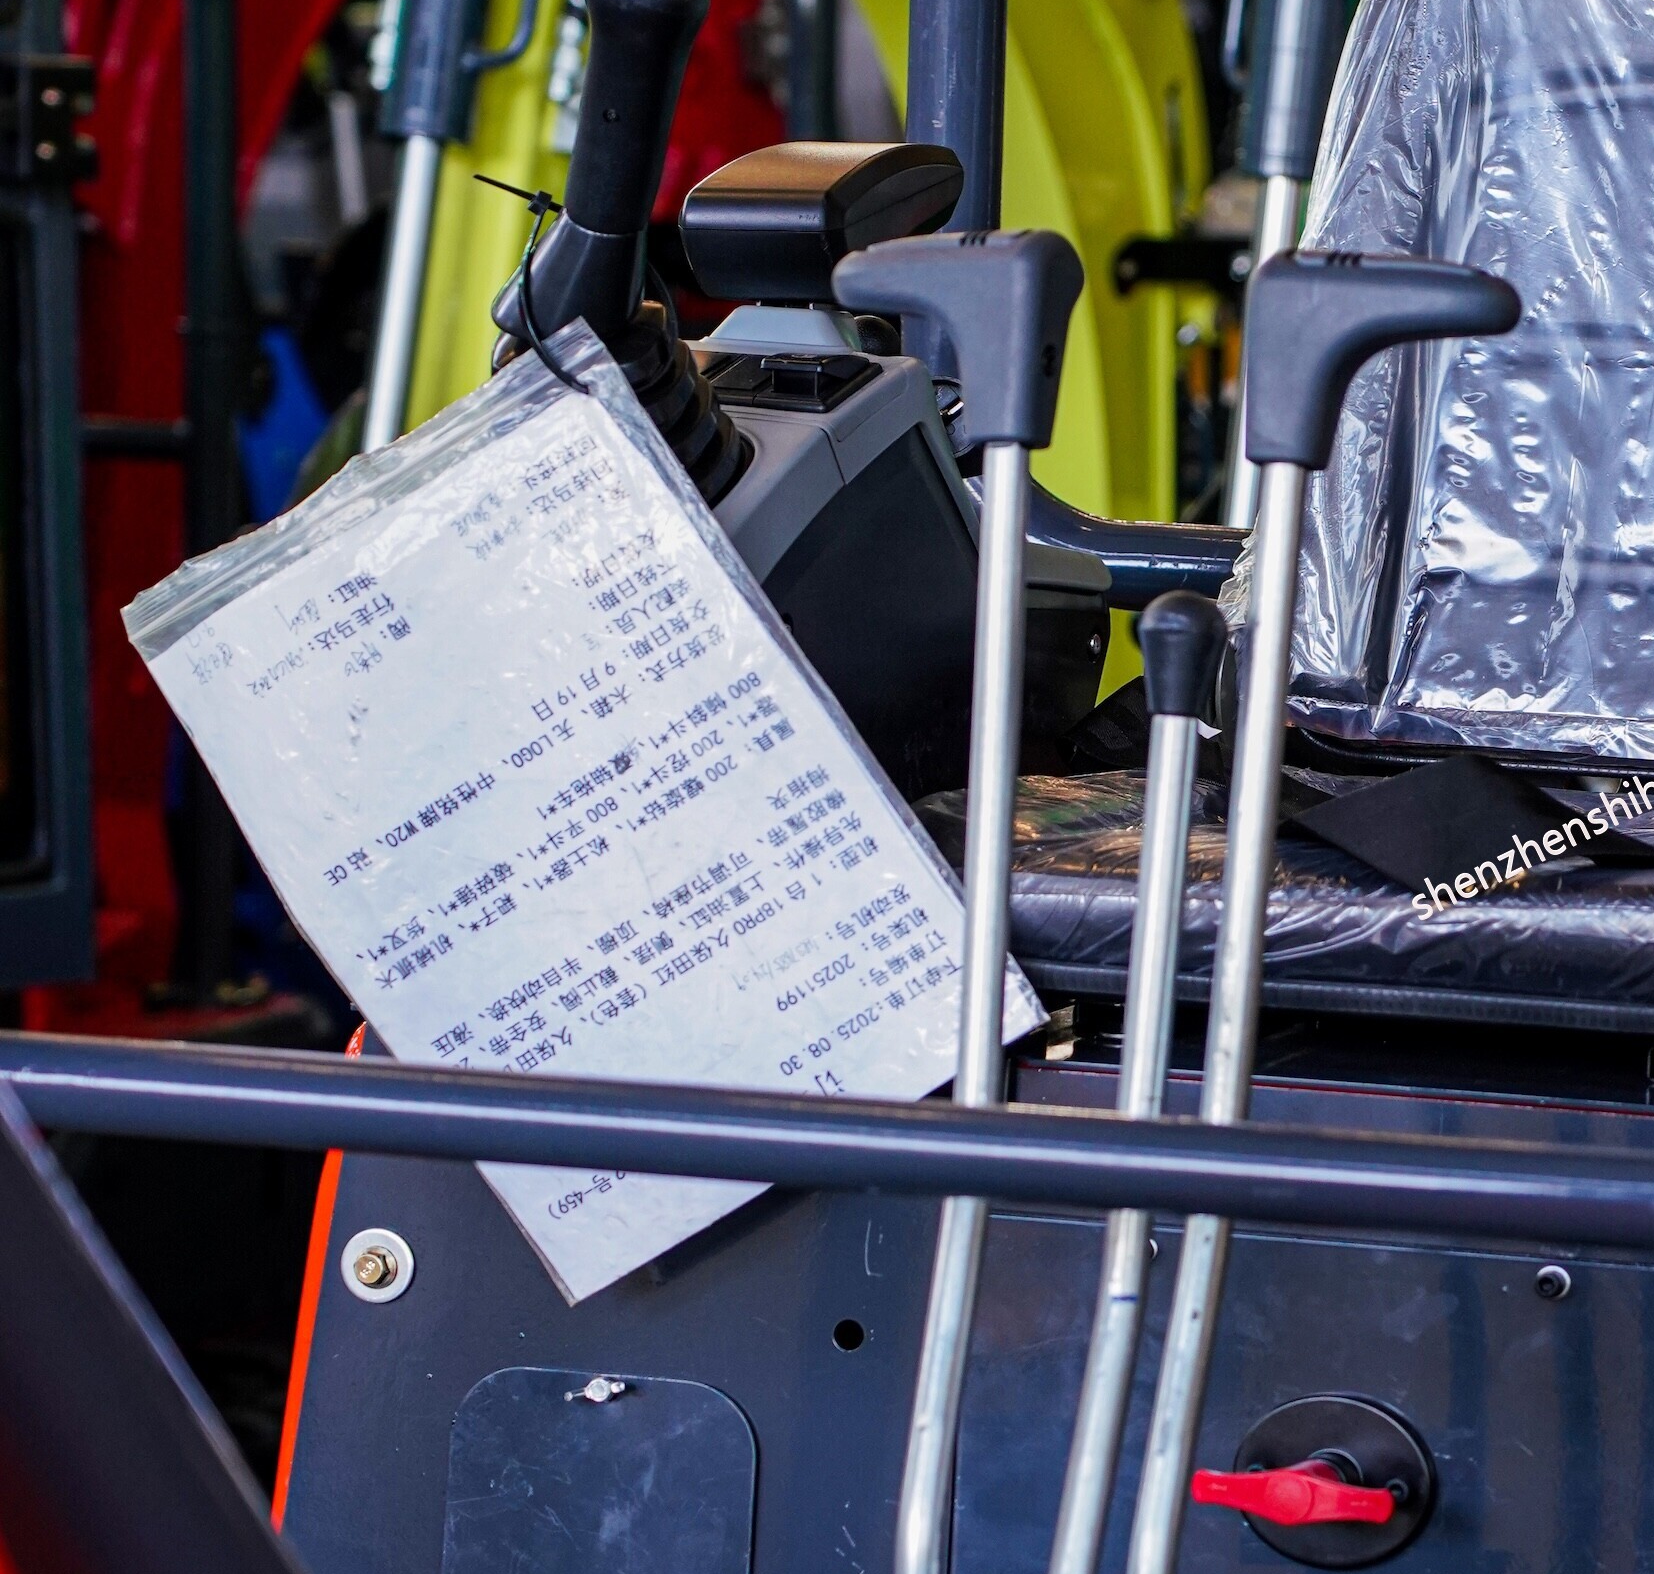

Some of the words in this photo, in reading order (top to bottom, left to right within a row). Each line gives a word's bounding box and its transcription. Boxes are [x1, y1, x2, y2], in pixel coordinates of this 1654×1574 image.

[326, 567, 379, 611] 油缸：
[304, 590, 397, 659] 行走马达：
[763, 761, 831, 814] 拇指夹
